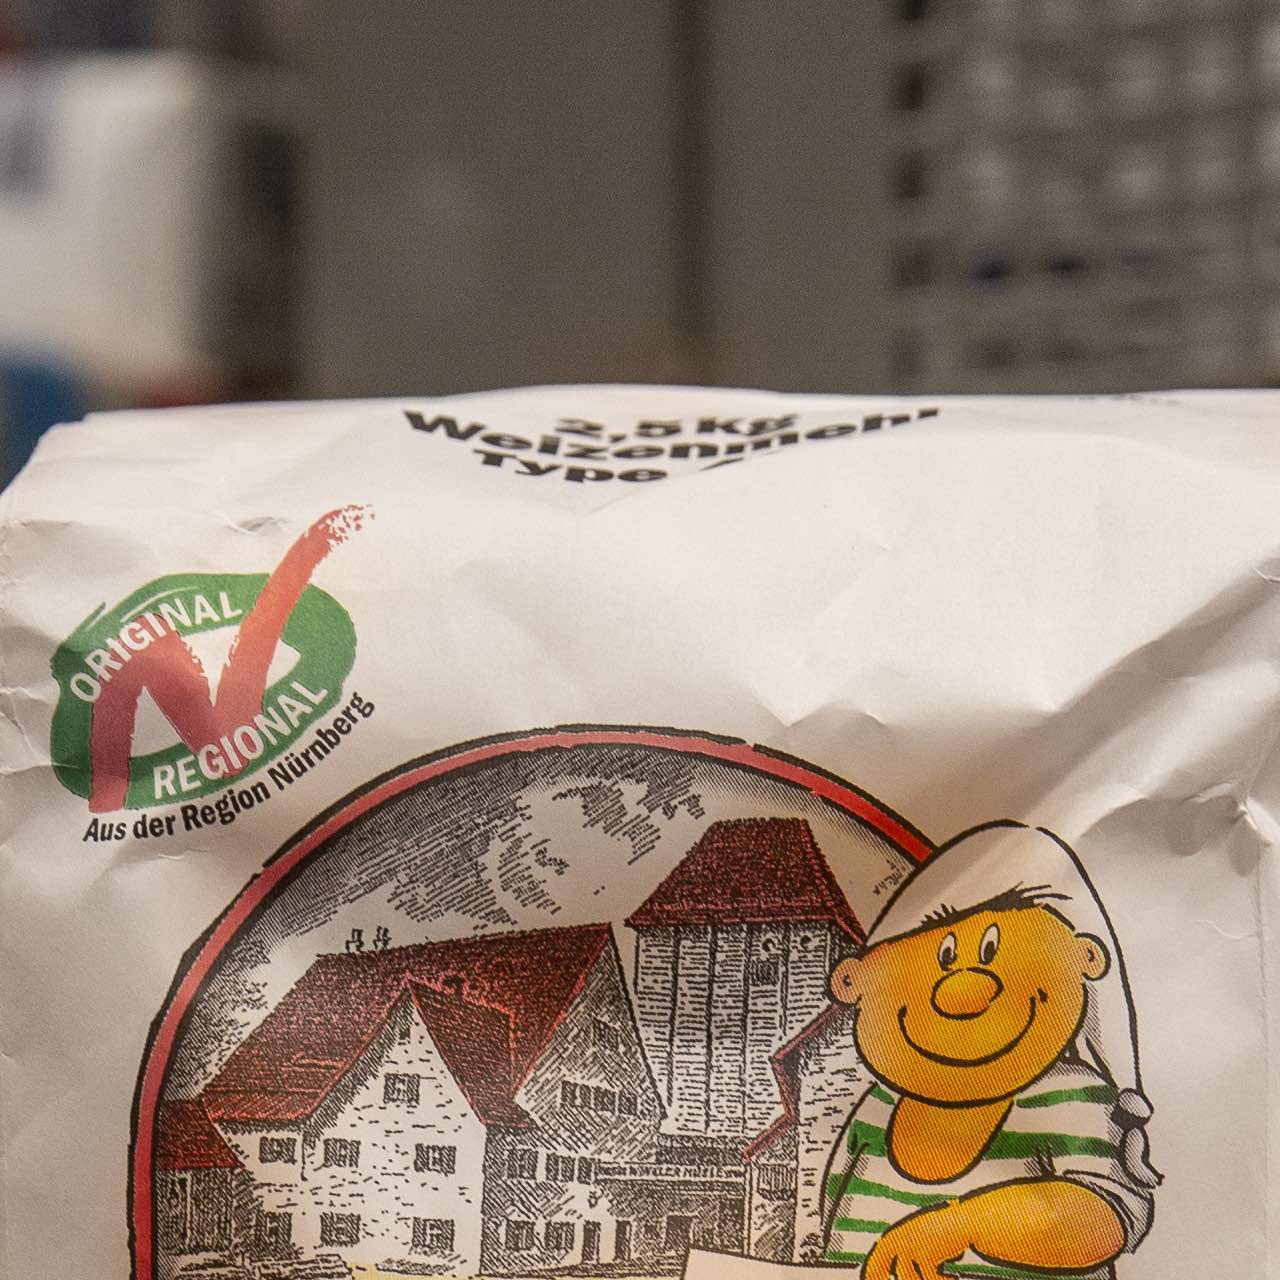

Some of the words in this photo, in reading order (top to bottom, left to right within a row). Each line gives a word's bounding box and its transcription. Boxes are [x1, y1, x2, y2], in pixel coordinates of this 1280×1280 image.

[404, 407, 940, 461] Weizenmehl
[473, 448, 668, 484] Type
[70, 591, 243, 702] ORIGINAL
[82, 817, 126, 843] Aus
[132, 813, 176, 839] der
[180, 782, 272, 833] Region
[266, 691, 376, 791] Nürnberg
[153, 680, 329, 800] REGIONAL
